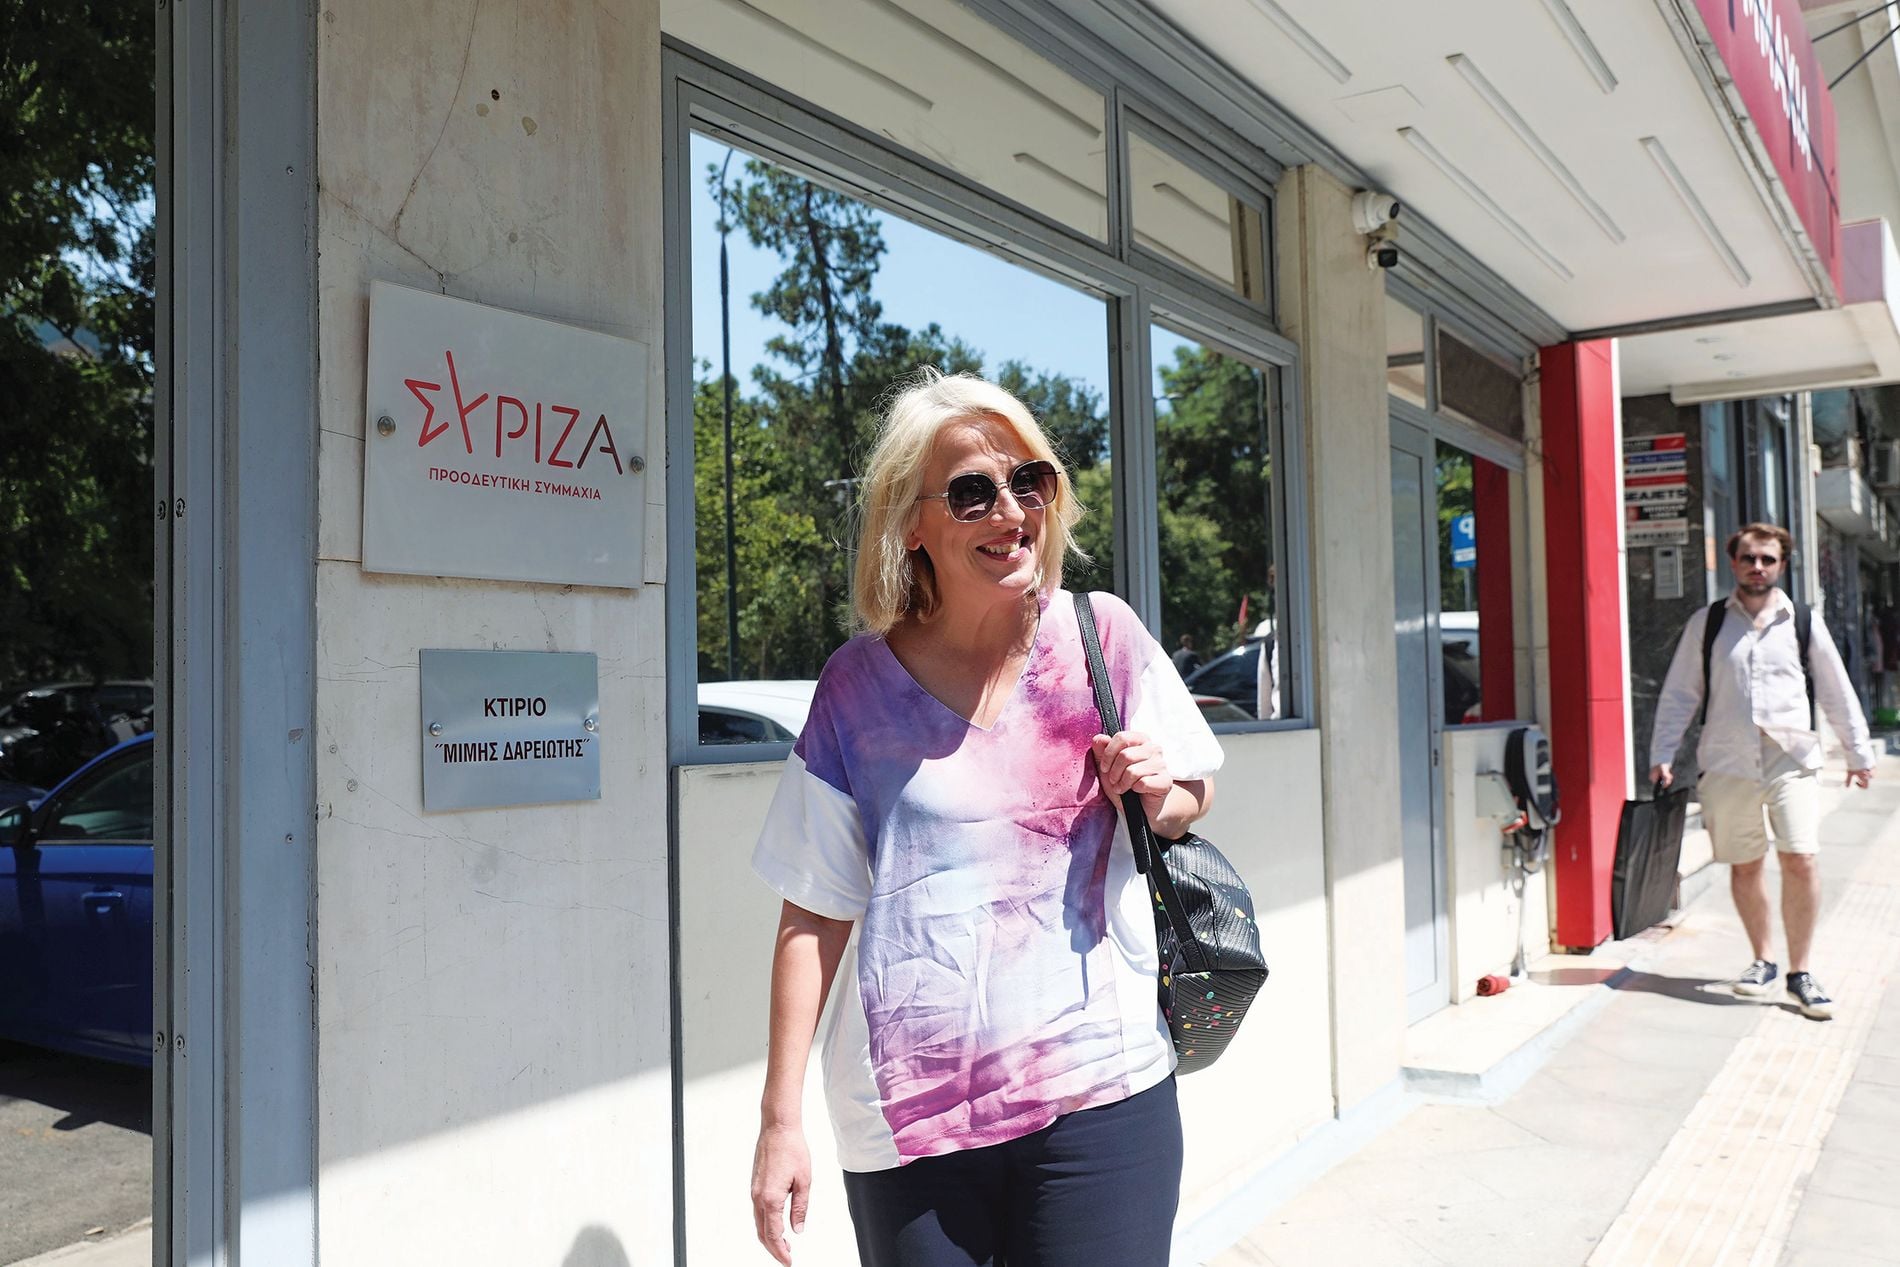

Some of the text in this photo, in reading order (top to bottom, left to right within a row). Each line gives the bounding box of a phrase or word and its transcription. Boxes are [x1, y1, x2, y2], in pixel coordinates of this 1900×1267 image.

[404, 350, 623, 475] ΣΥΡΙΖΑ
[429, 467, 601, 501] ΠΡΟΟΔΕΥΤΙΚΗ ΣΥΜΜΑΧΙΑ
[484, 697, 547, 717] ΚΤΙΡΙΟ
